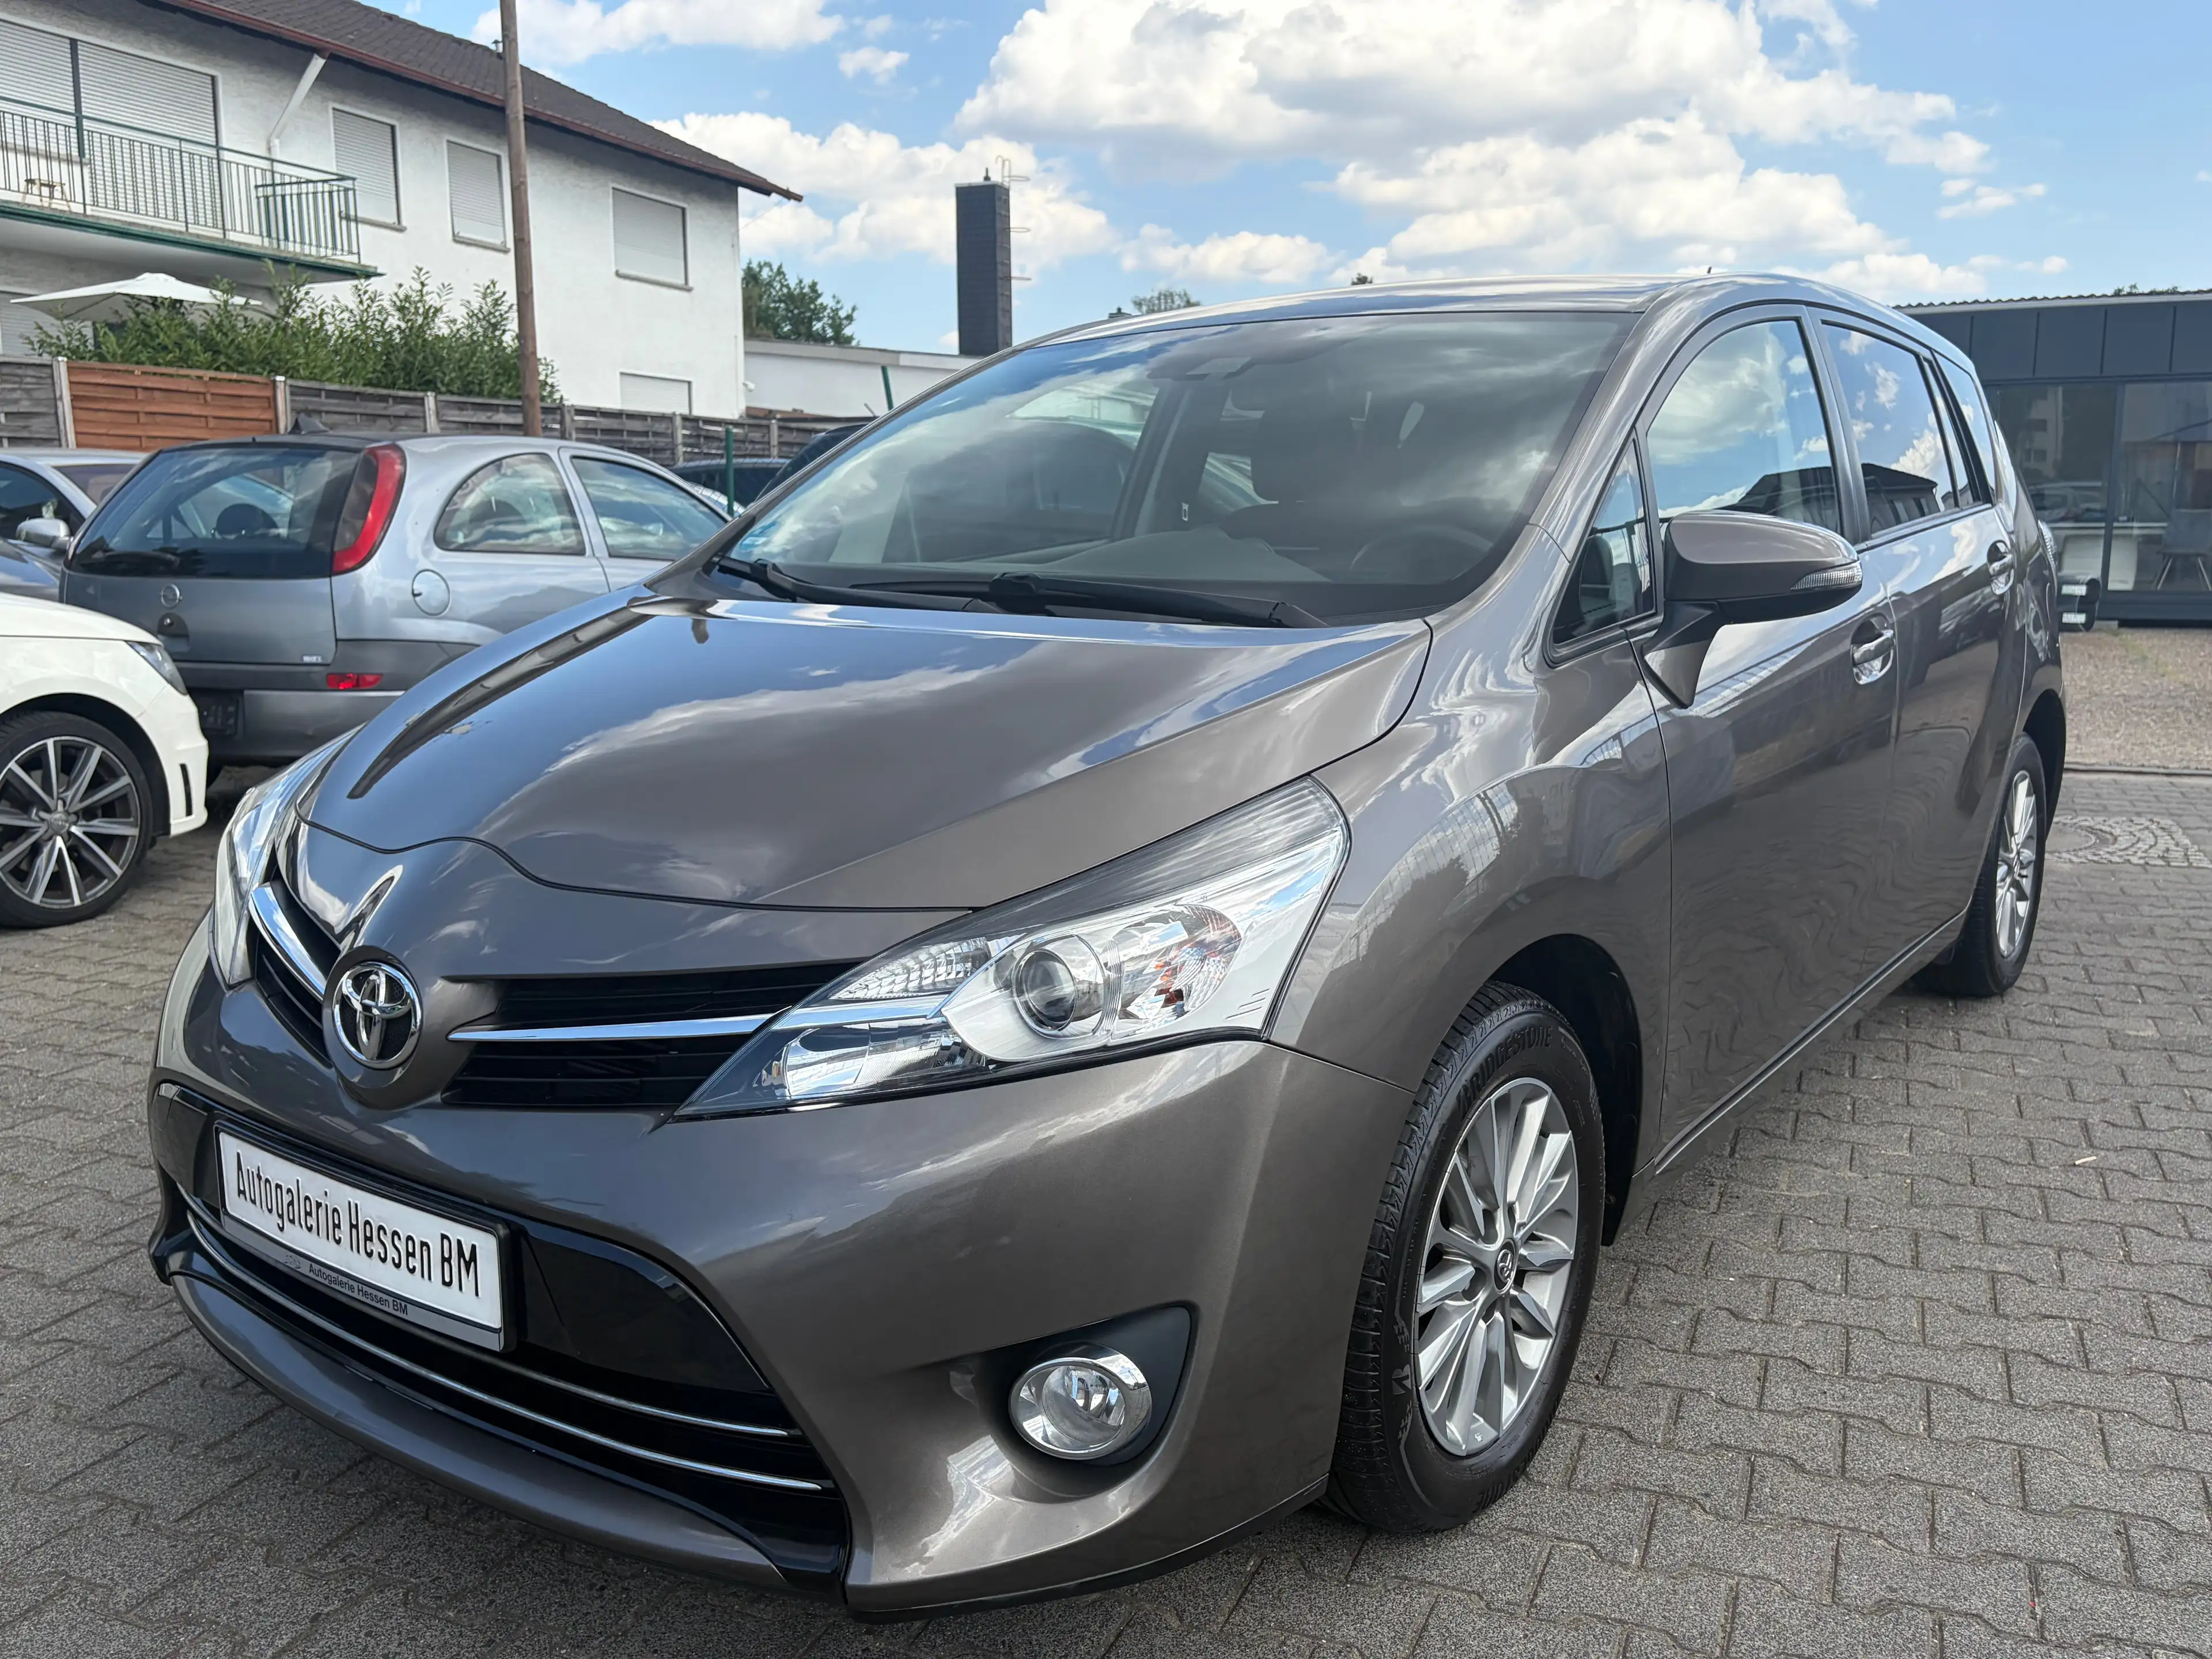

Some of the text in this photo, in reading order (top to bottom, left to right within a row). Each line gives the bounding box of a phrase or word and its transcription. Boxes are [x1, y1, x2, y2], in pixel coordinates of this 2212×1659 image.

[236, 1151, 480, 1297] Autogalerie Hessen BM
[309, 1263, 408, 1316] Autogalerie Hessen BM
